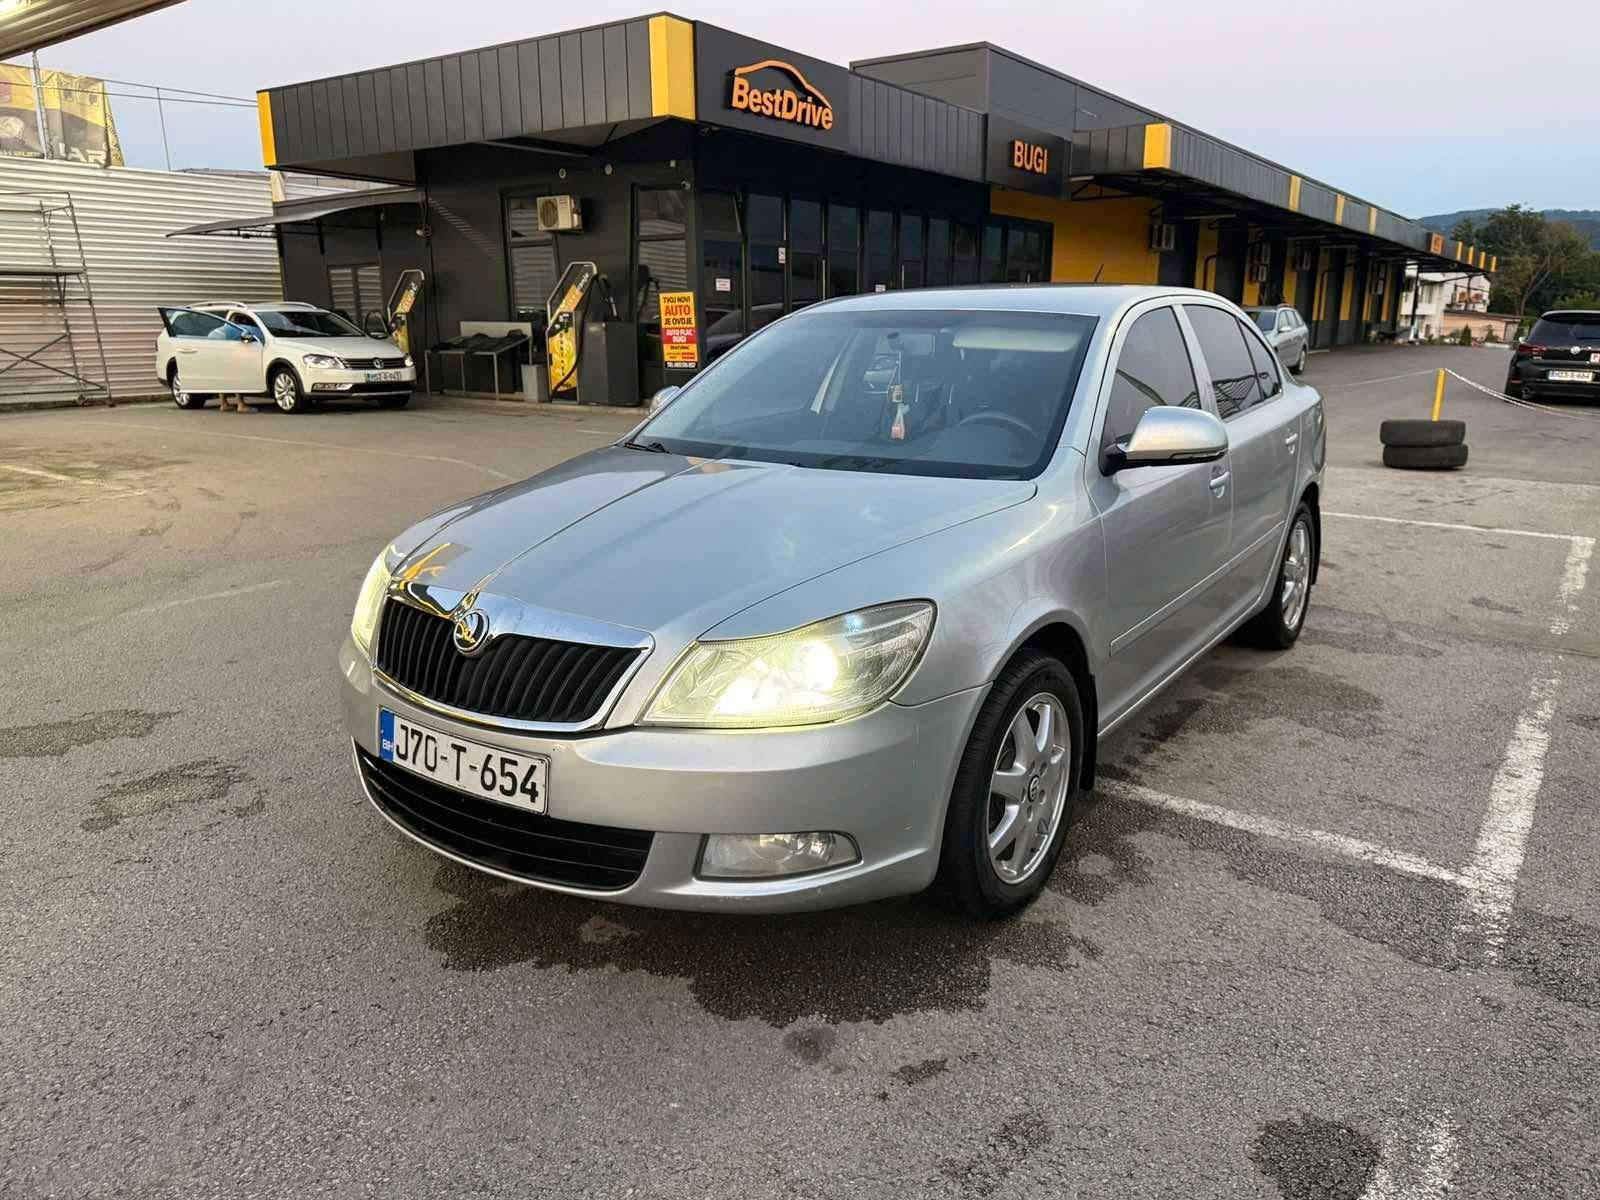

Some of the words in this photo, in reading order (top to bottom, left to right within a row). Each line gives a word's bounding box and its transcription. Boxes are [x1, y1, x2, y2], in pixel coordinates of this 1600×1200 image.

[731, 76, 833, 130] BestDrive
[1013, 139, 1048, 175] BUGI
[663, 295, 677, 303] TVOJ
[677, 295, 691, 303] NOVI
[664, 304, 691, 316] AUTO
[672, 317, 693, 325] OVDJE
[395, 723, 540, 804] J70-T-654
